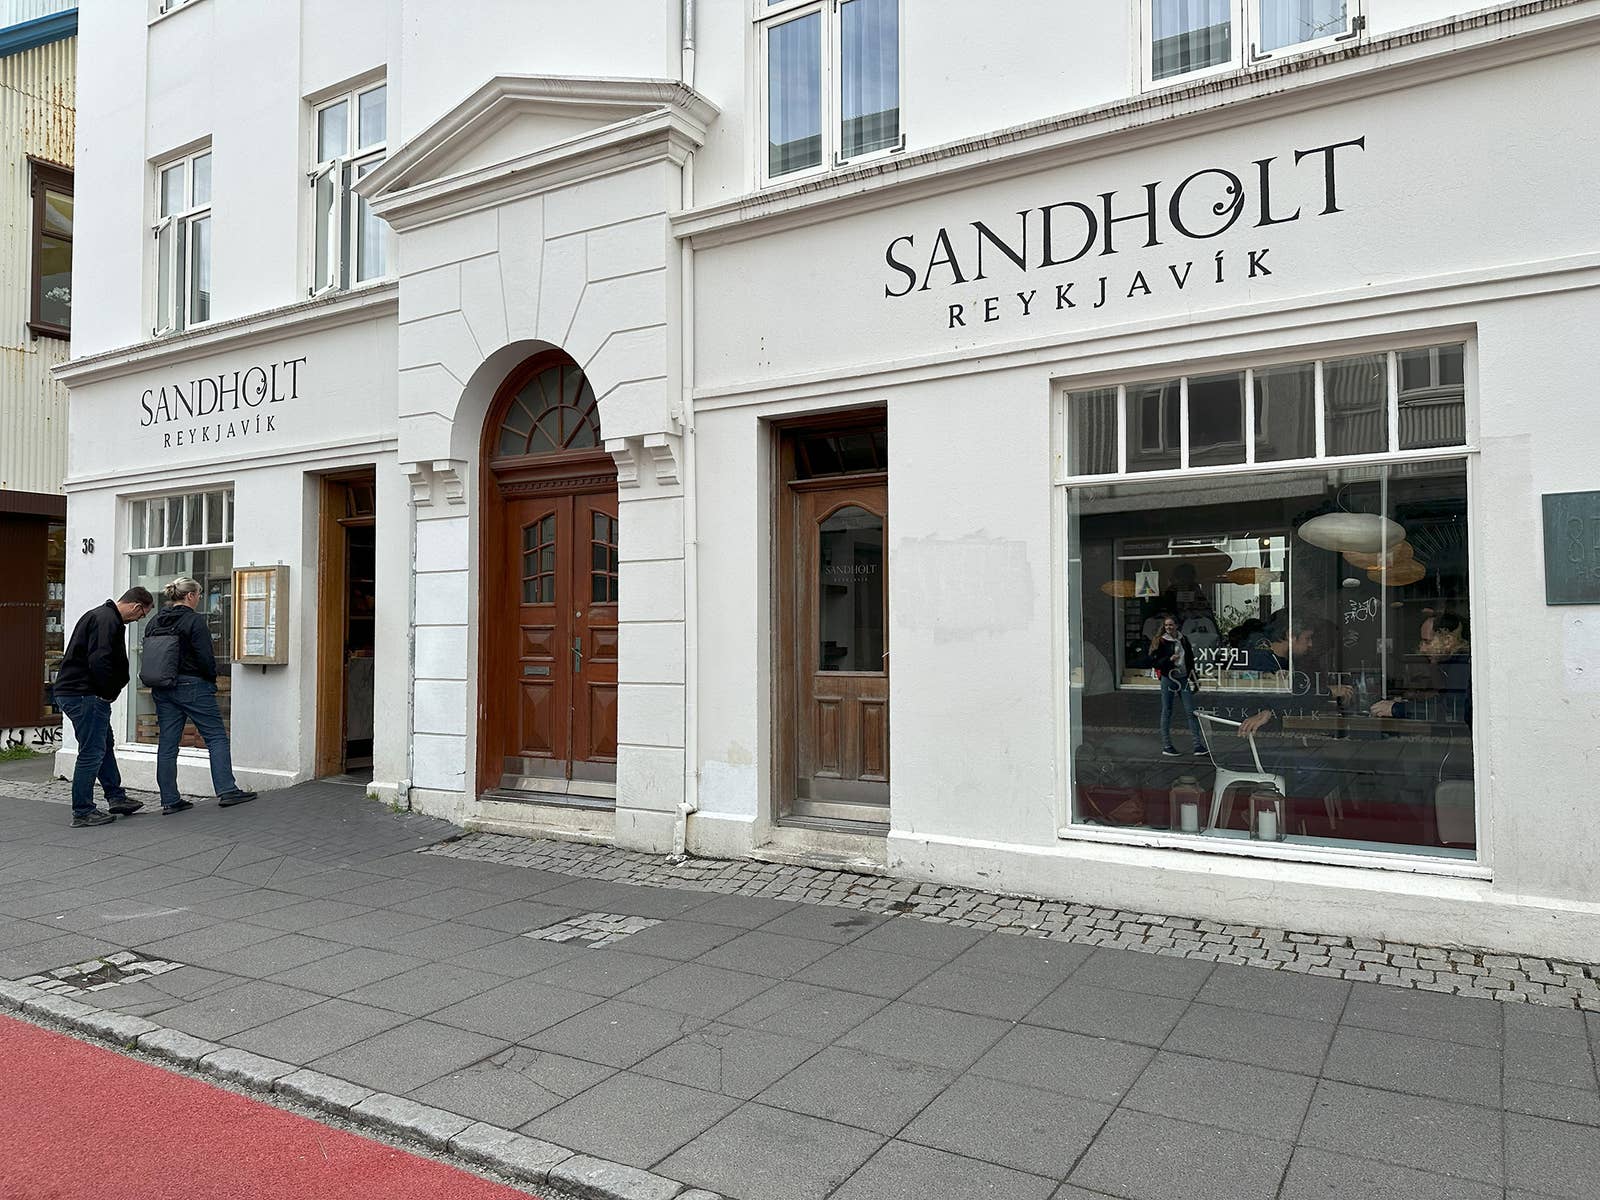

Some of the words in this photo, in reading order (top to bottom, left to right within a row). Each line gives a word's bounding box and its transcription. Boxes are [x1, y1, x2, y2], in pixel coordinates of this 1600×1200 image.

[885, 135, 1366, 299] SANDHOLT
[948, 248, 1272, 329] REYKJAVÍK
[140, 356, 307, 427] SANDHOLT
[164, 415, 276, 448] REYKJAVÍK
[82, 538, 95, 555] 36
[824, 564, 877, 575] SANDHOLT
[1197, 706, 1320, 721] REYKAVÍK
